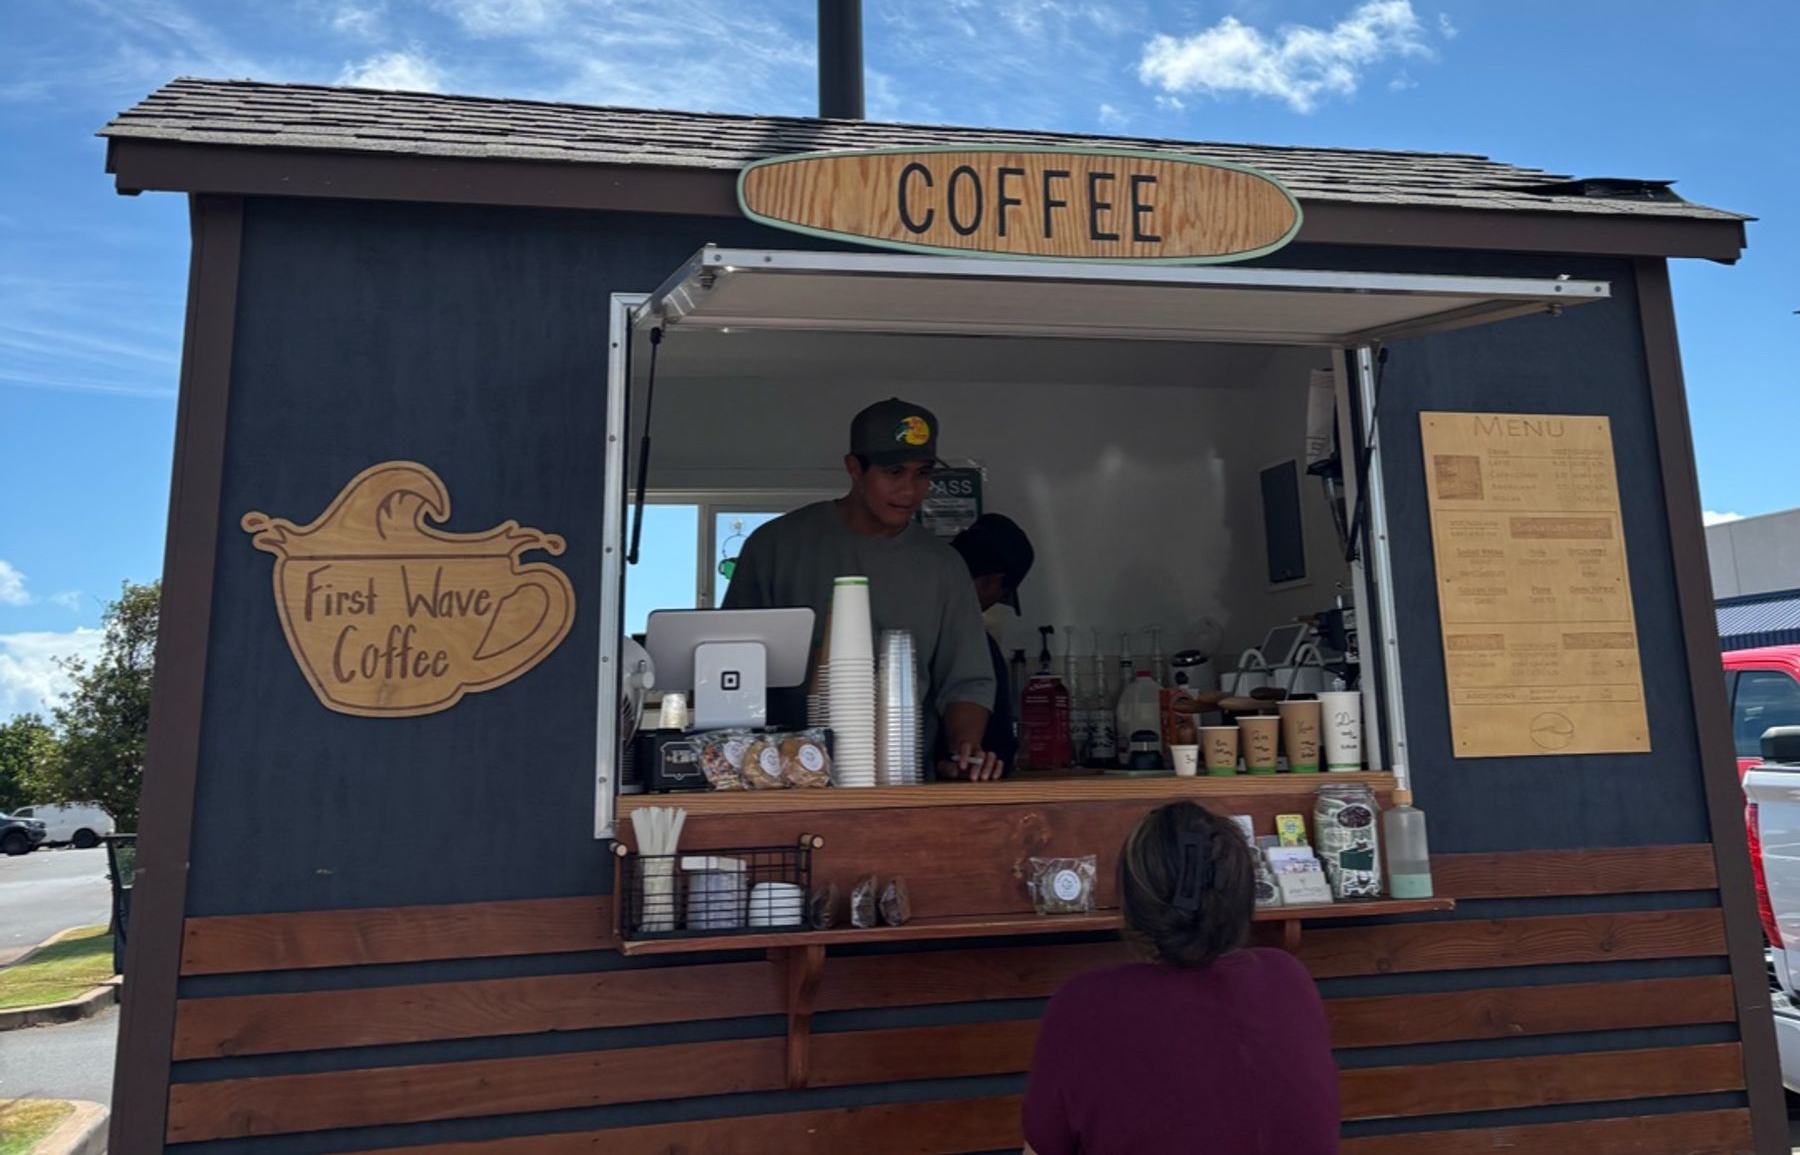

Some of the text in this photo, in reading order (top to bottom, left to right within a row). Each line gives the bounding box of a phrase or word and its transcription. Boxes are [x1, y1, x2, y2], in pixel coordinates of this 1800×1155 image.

[899, 161, 1162, 243] COFFEE
[1473, 415, 1566, 438] MENU
[304, 564, 493, 622] First Wave
[332, 624, 451, 684] Coffee
